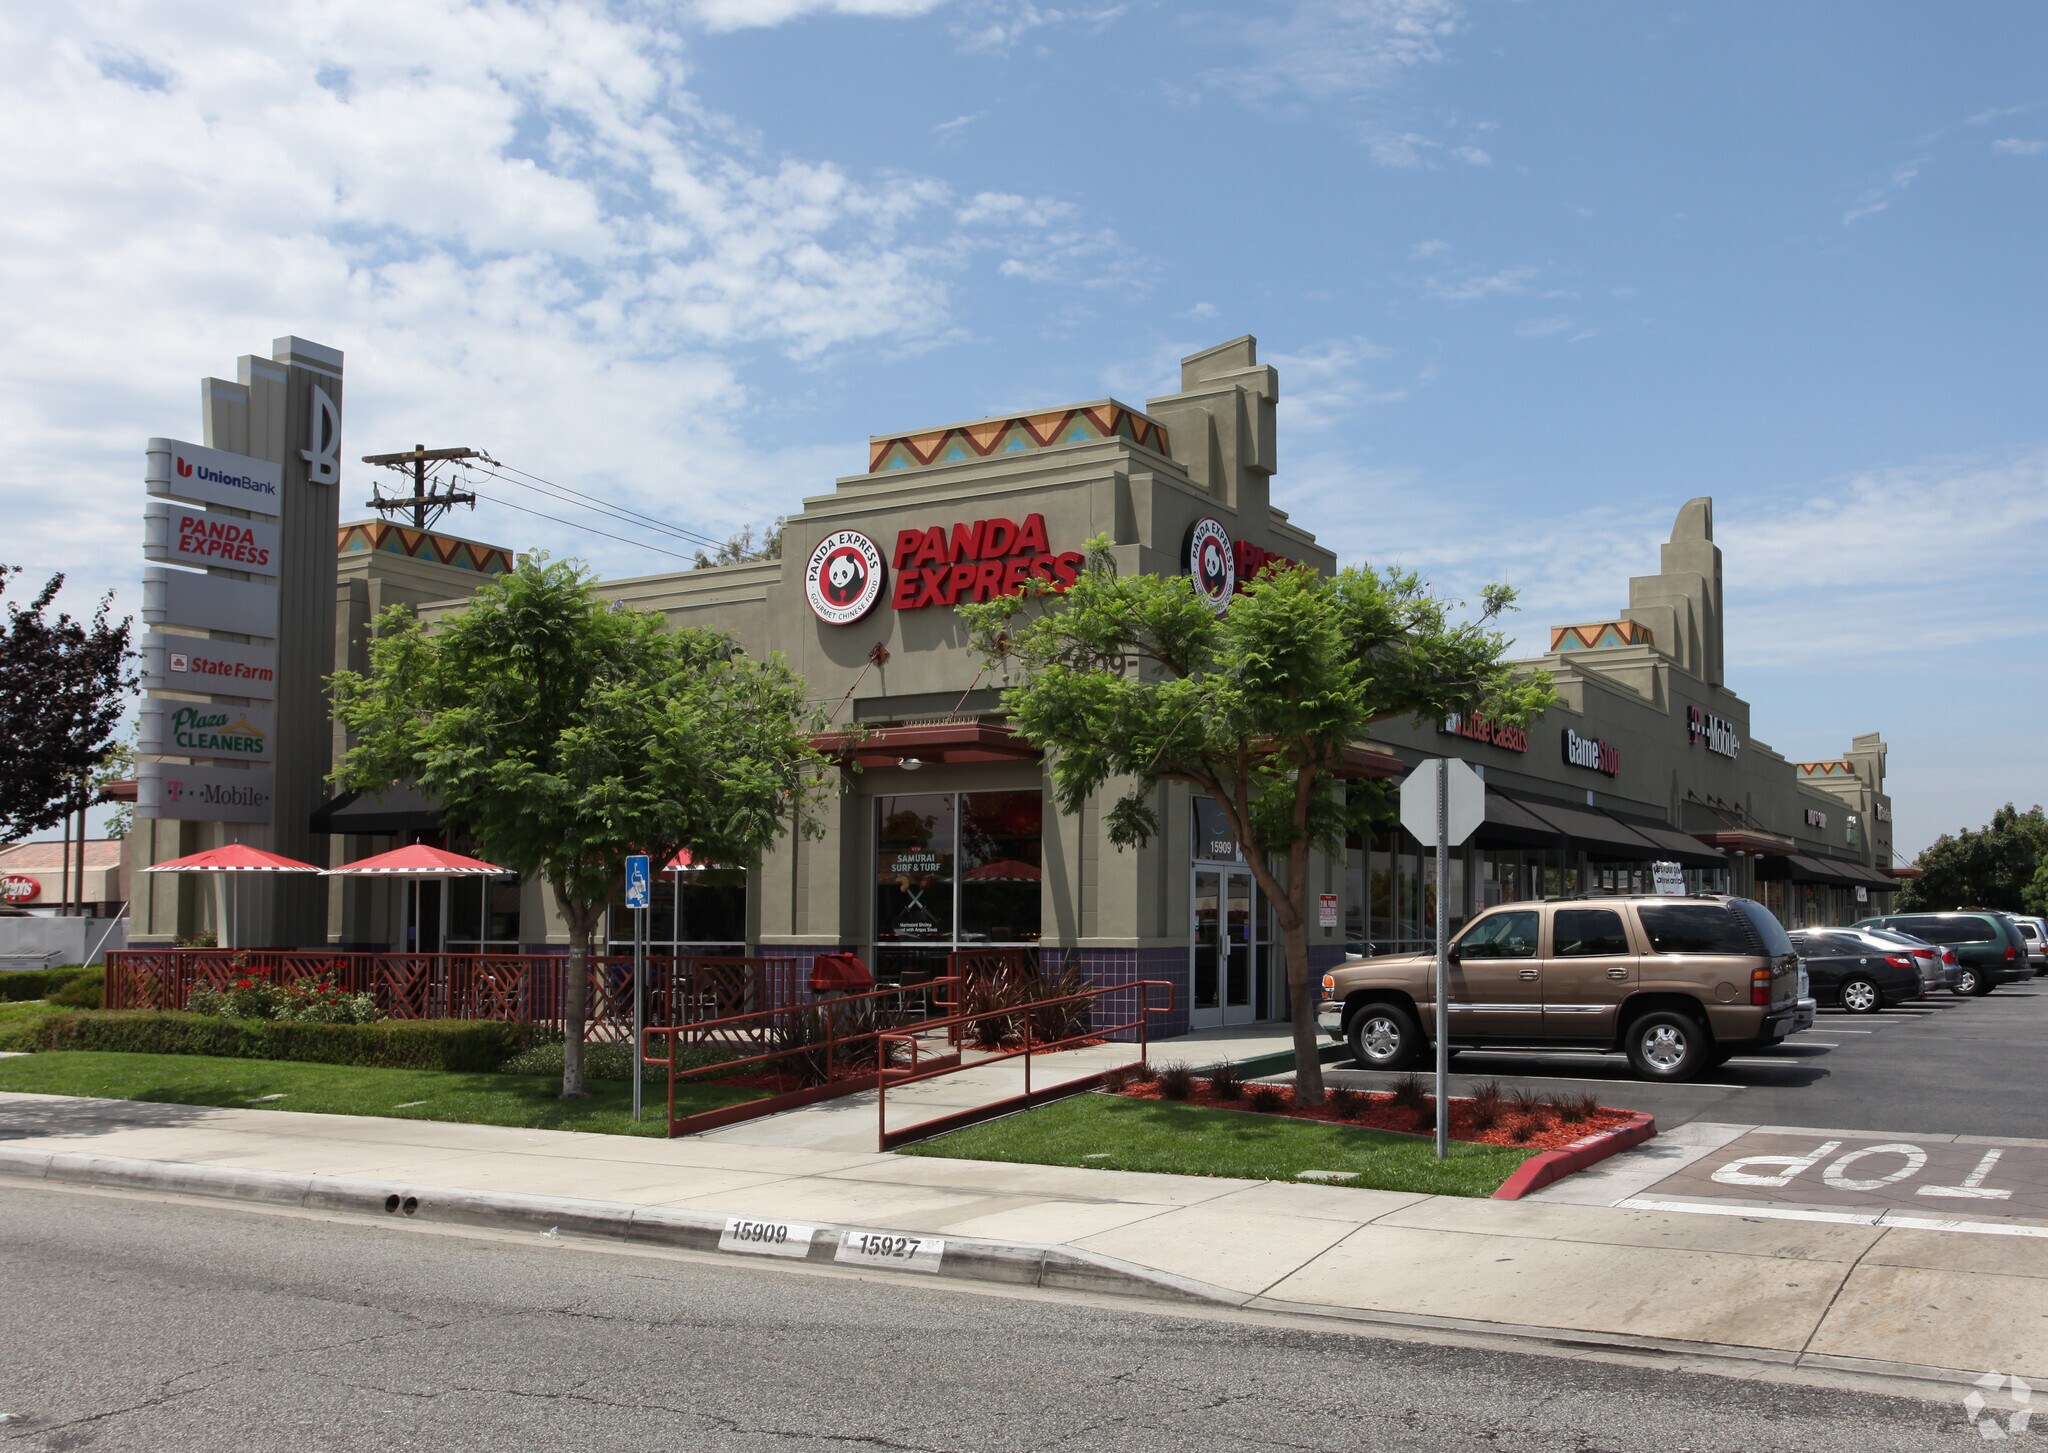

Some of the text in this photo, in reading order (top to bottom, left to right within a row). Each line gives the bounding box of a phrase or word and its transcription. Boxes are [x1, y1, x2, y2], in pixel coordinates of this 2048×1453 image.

[197, 466, 275, 496] UnionBank
[179, 516, 254, 546] PANDA
[892, 513, 1050, 570] PANDA
[178, 535, 270, 566] EXPRESS
[809, 534, 878, 581] PANDA EXPRESS
[1193, 523, 1210, 558] PANDA
[1212, 523, 1233, 572] EXPRESS
[892, 551, 1084, 610] EXPRESS
[811, 580, 878, 620] GOURMET CHINESE FOOD
[192, 658, 273, 681] State Farm
[172, 707, 228, 735] Plaza
[176, 732, 264, 753] CLEANERS
[1568, 729, 1621, 776] GameStop
[898, 854, 934, 862] SAMURAI
[1210, 841, 1232, 854] 15909
[892, 864, 940, 872] SURF & TURF
[733, 1221, 788, 1244] 15909
[860, 1234, 921, 1259] 15927
